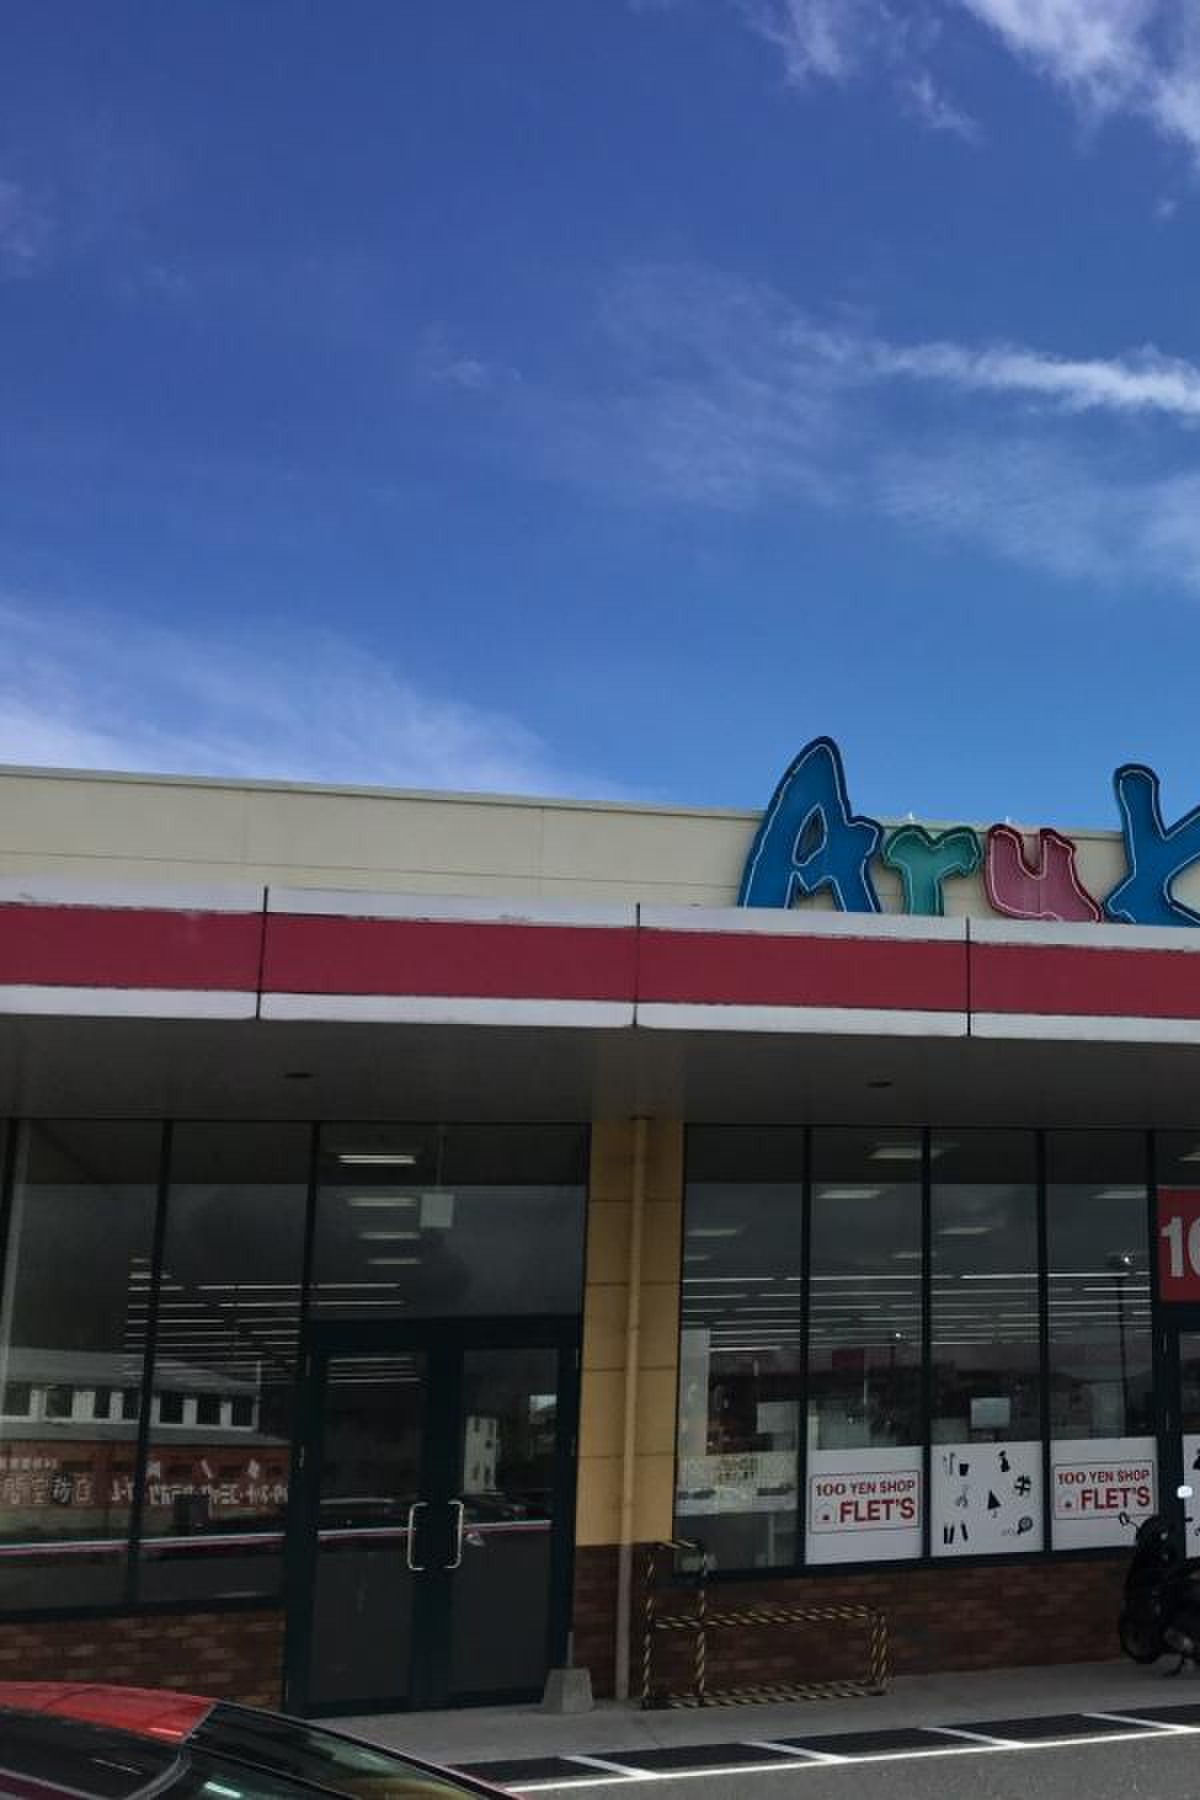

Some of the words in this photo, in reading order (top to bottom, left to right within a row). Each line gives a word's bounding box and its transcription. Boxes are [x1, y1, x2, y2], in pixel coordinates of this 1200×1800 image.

[1057, 1471, 1086, 1485] 100
[1088, 1471, 1115, 1484] YEN
[1117, 1469, 1150, 1483] SHOP
[816, 1483, 847, 1497] 100
[849, 1481, 877, 1495] YEN
[879, 1480, 916, 1494] SHOP
[1080, 1486, 1151, 1511] FLET'S
[840, 1497, 915, 1523] FLET'S
